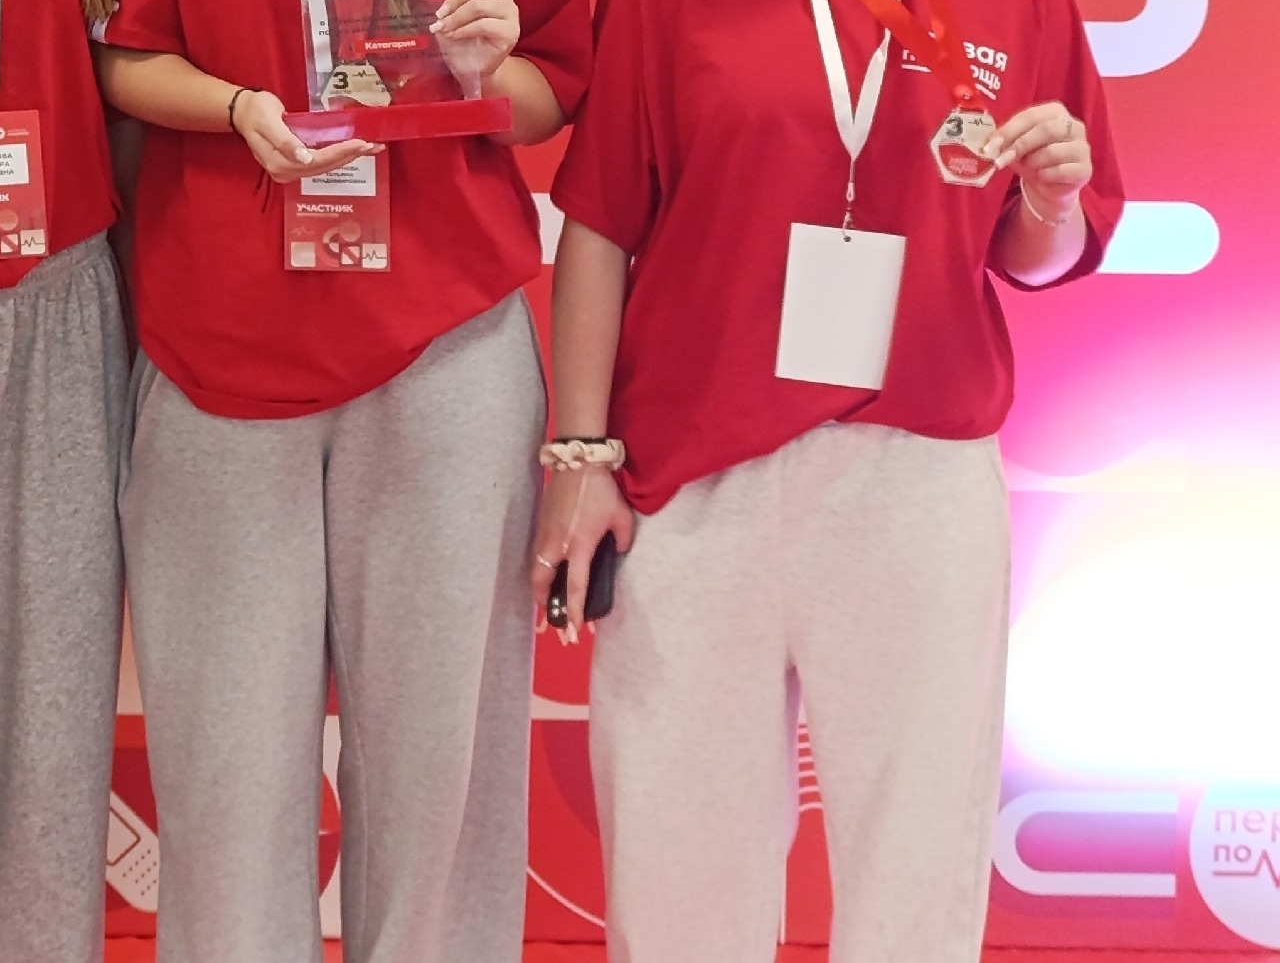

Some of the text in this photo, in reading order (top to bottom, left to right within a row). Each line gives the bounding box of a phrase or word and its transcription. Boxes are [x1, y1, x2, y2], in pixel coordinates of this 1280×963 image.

[364, 39, 417, 50] Категория
[332, 71, 350, 90] 3
[945, 116, 964, 137] 3
[296, 203, 354, 214] УЧАСТНИК
